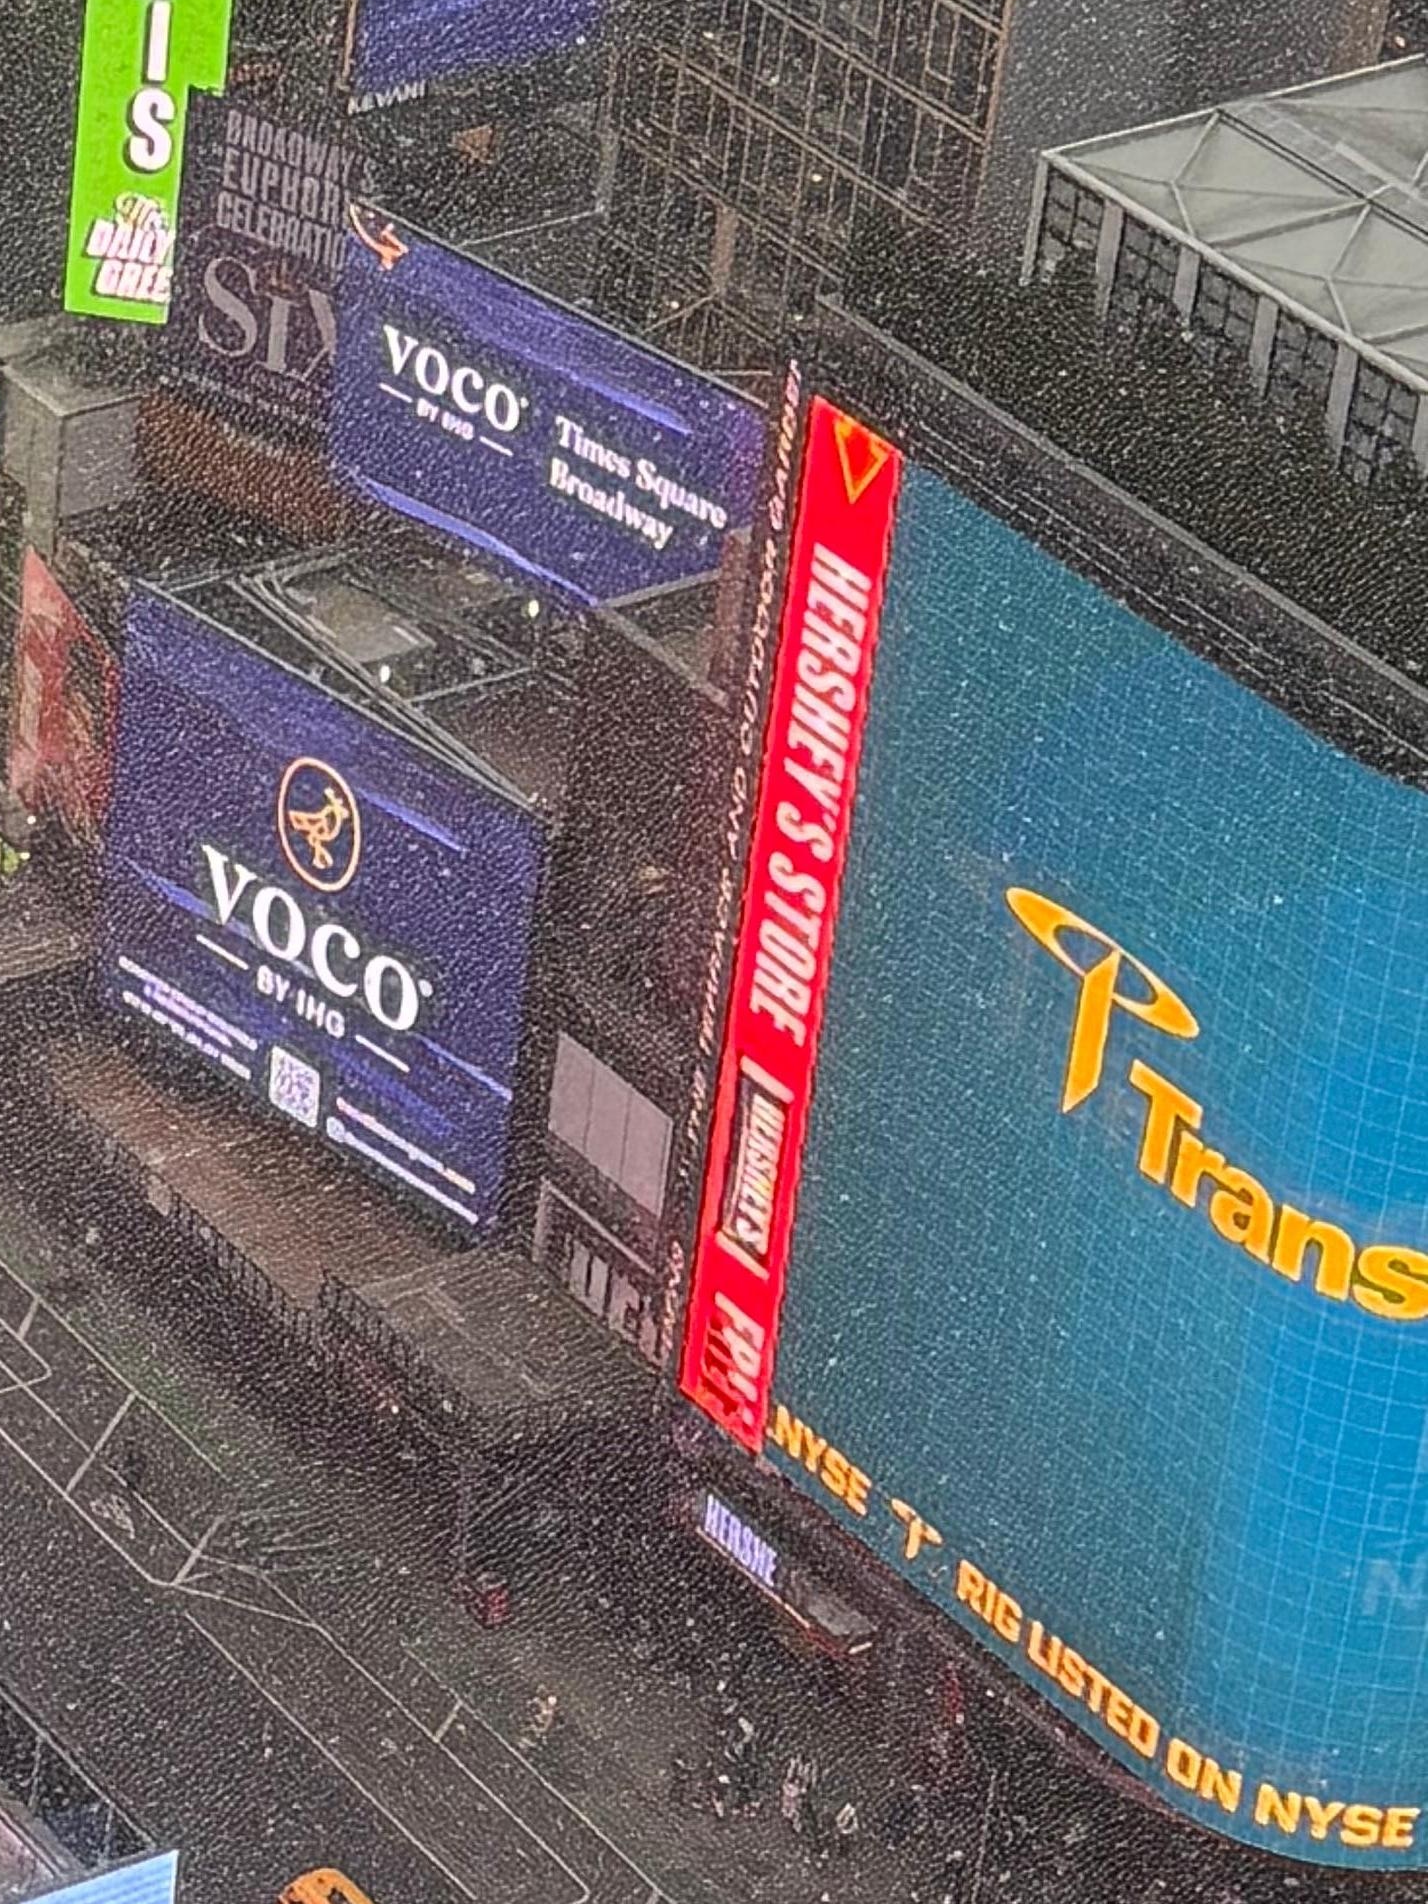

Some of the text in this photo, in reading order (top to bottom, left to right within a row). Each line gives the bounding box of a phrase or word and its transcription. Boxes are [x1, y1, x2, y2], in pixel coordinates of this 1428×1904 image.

[549, 456, 673, 551] Broadway
[555, 415, 728, 529] Times Square
[749, 541, 873, 1049] HERSHEY'S STORE
[256, 964, 290, 1002] BY
[296, 988, 346, 1039] IHG
[1128, 1057, 1428, 1322] Trans
[773, 1403, 874, 1517] NYSE
[954, 1558, 1421, 1849] RIG LISTED ON NYSE
